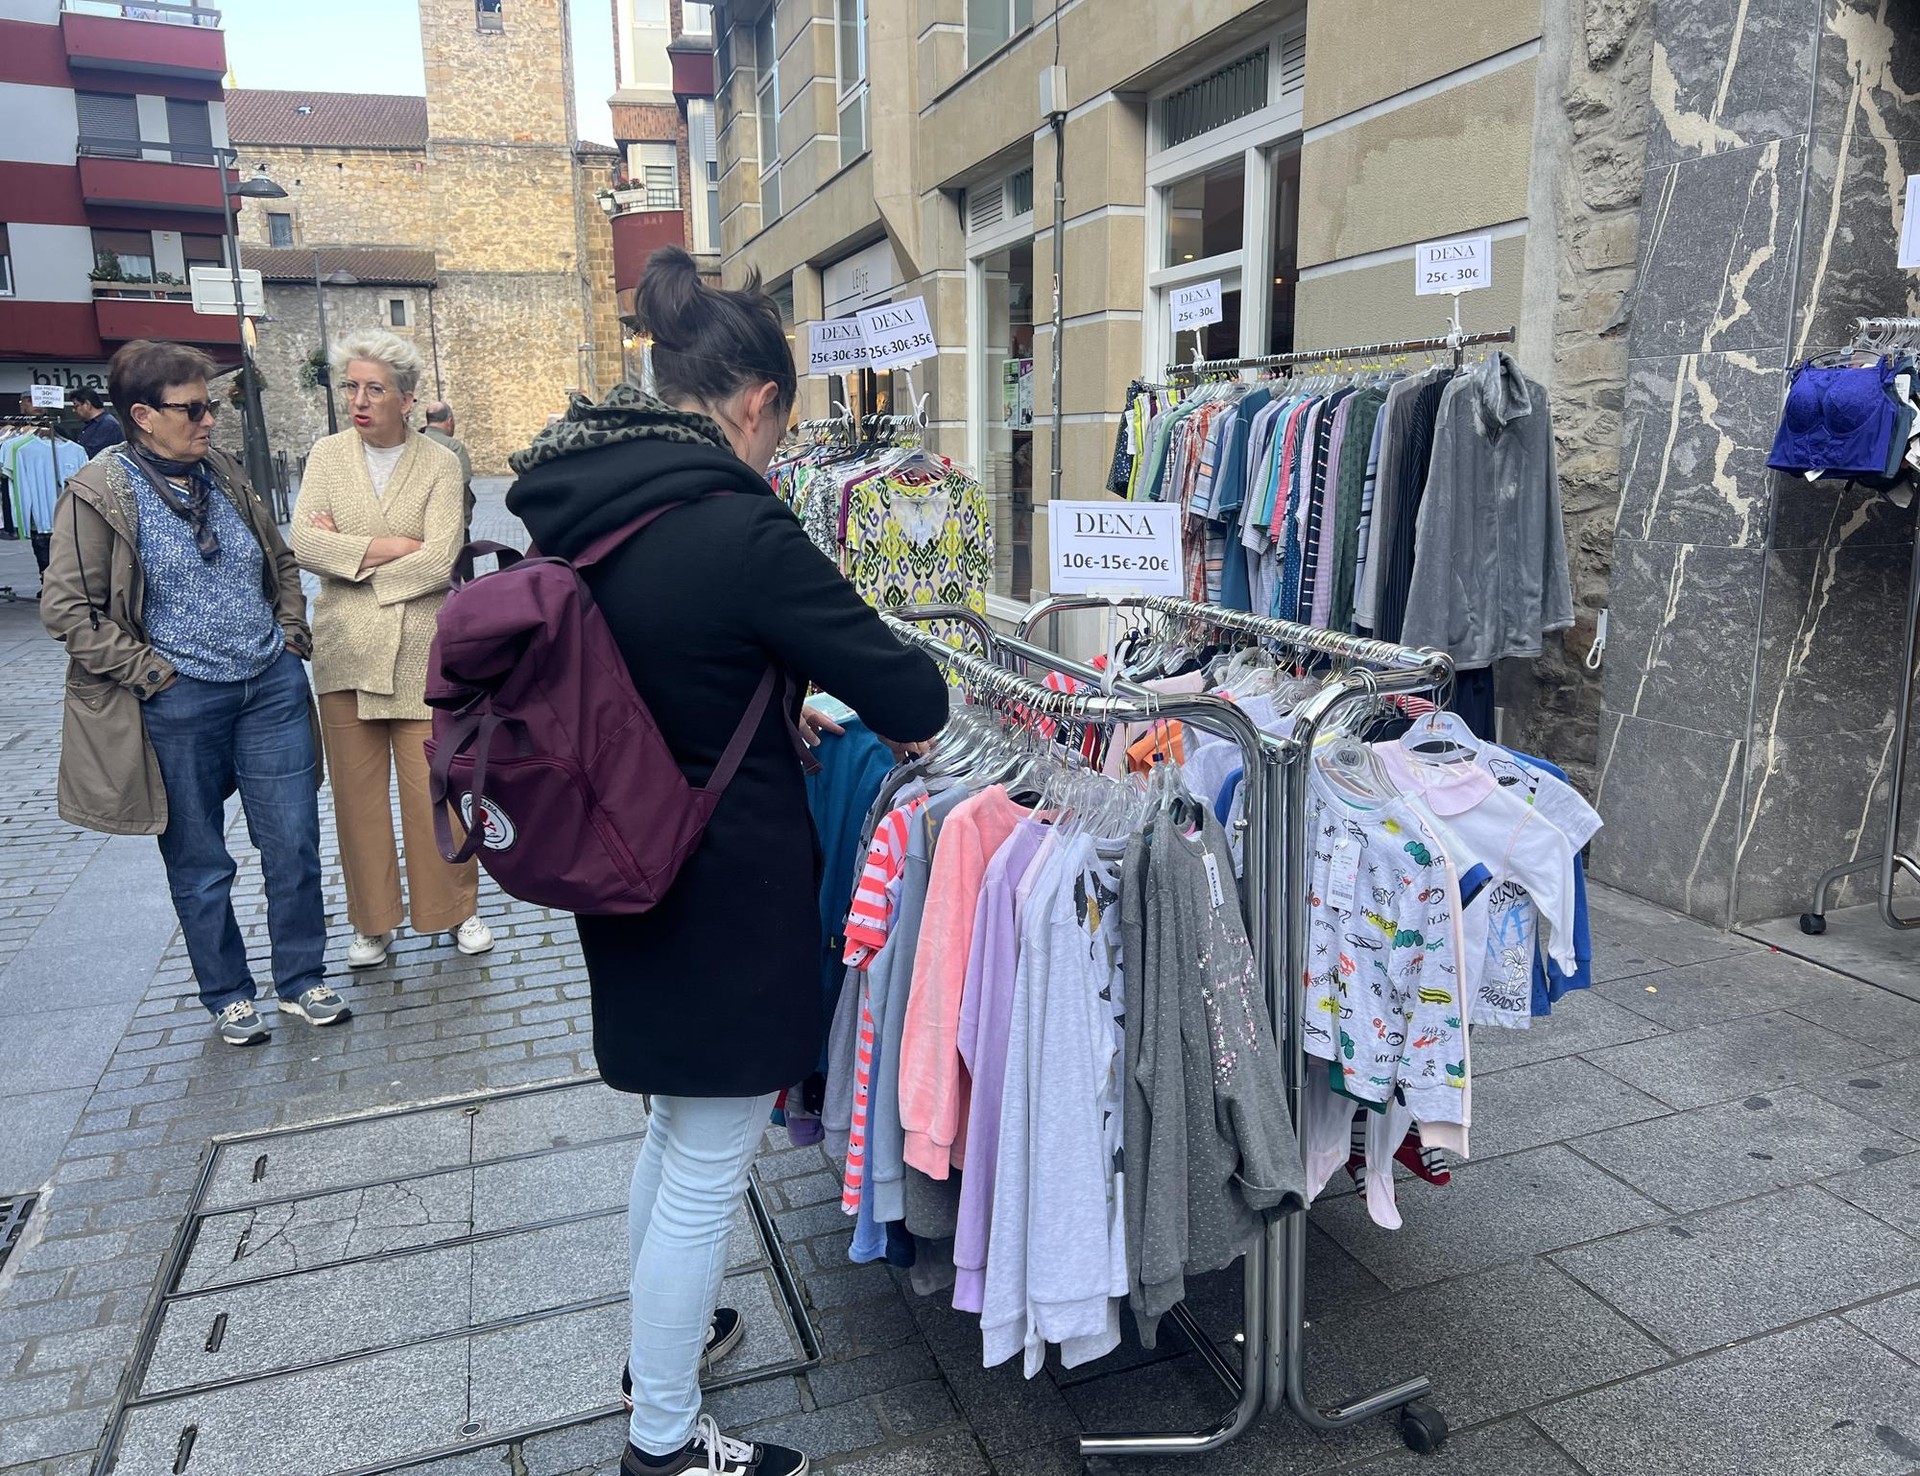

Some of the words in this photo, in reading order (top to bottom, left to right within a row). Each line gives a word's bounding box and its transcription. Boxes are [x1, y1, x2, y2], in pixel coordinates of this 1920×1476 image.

[1429, 245, 1475, 261] DENA
[1426, 272, 1448, 283] 25€
[1457, 268, 1479, 280] 30€
[1180, 288, 1211, 304] DENA
[871, 308, 914, 331] DENA
[1178, 311, 1193, 322] 25€
[1199, 306, 1214, 318] 30€
[821, 325, 861, 340] DENA
[869, 333, 933, 359] 25€-30€-35€
[811, 347, 867, 363] 25€-30€-35
[1075, 512, 1155, 536] DENA
[1063, 553, 1169, 571] 10€-15€-20€
